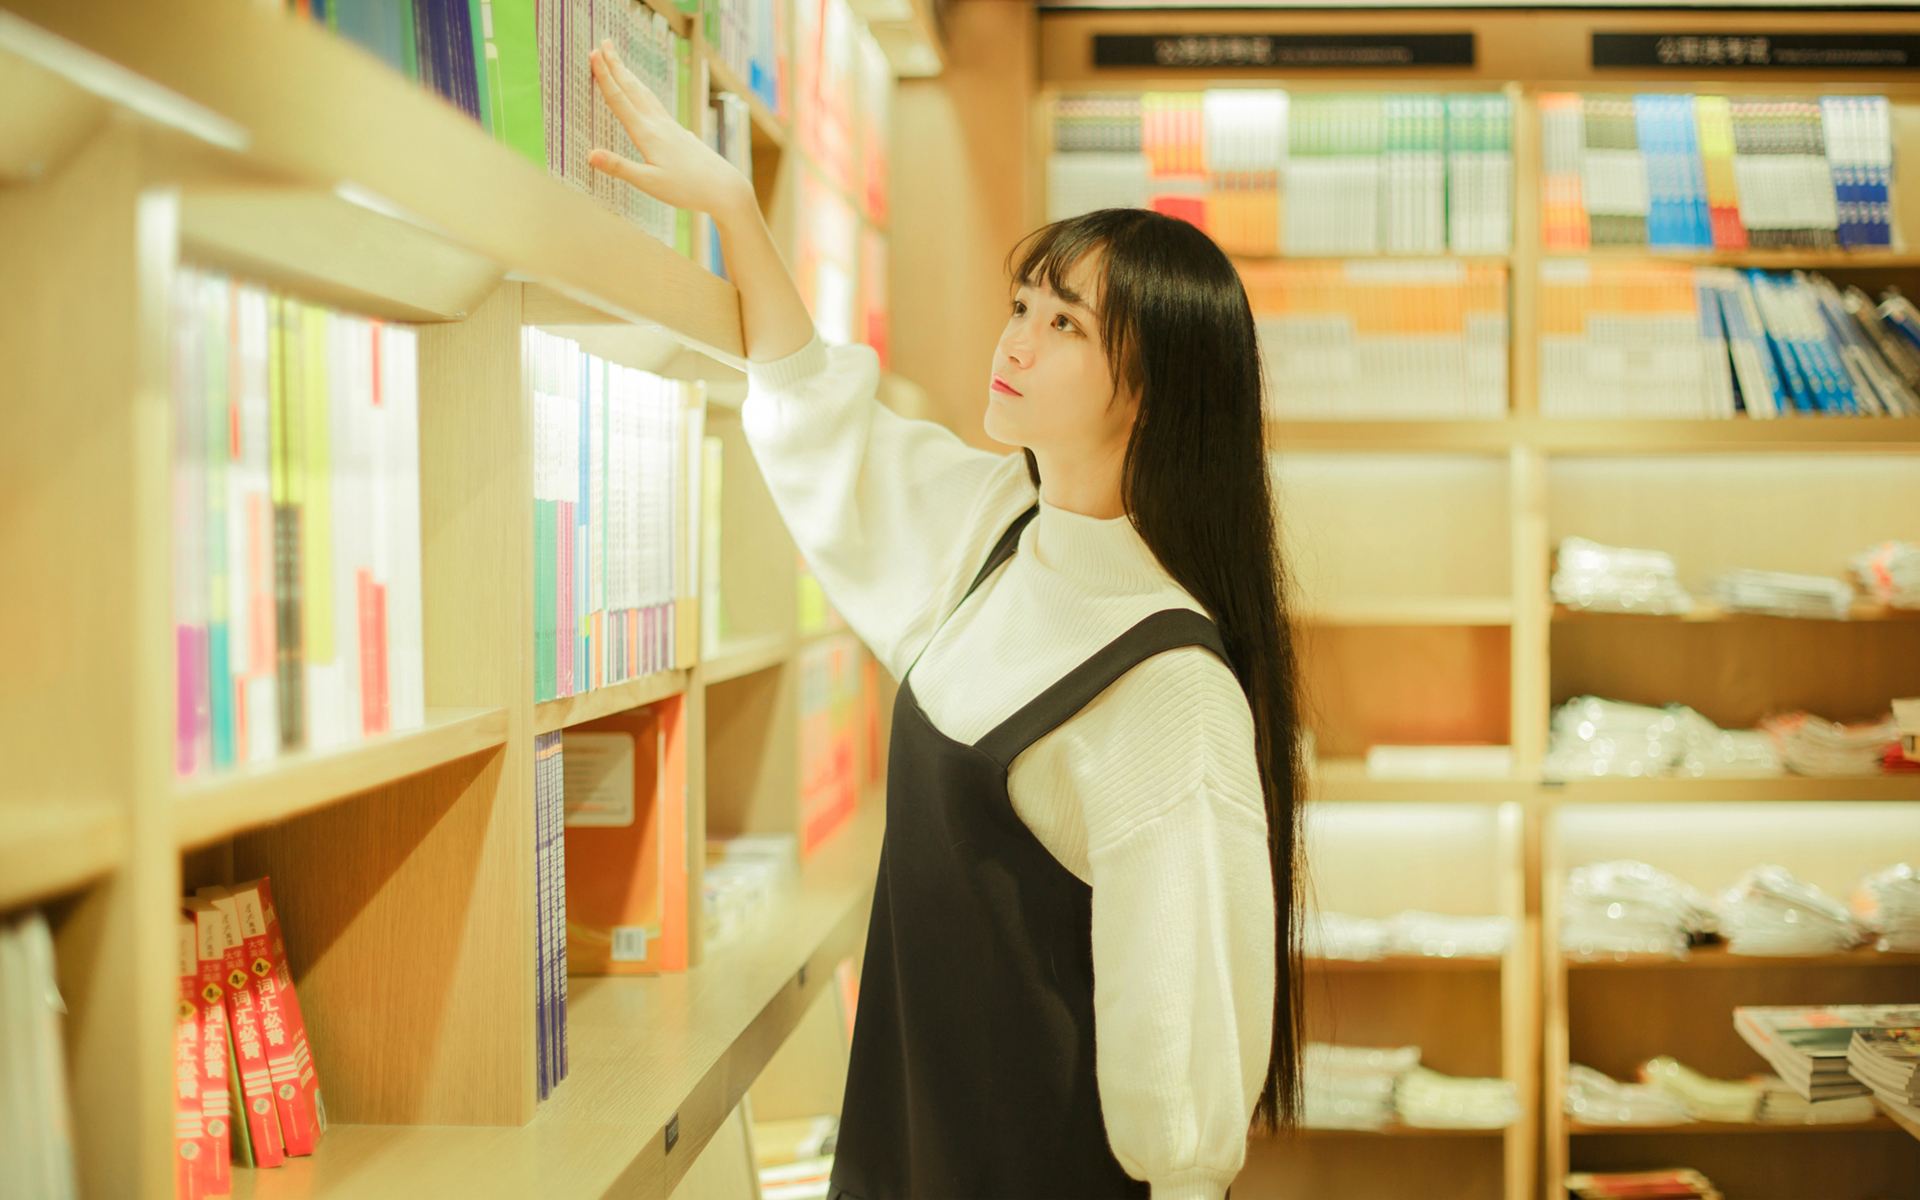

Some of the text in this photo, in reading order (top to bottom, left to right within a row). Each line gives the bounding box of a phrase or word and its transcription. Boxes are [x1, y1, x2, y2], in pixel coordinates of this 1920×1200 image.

[204, 1005, 225, 1079] 词汇必背
[232, 990, 260, 1060] 词汇必背
[256, 978, 285, 1047] 词汇必背
